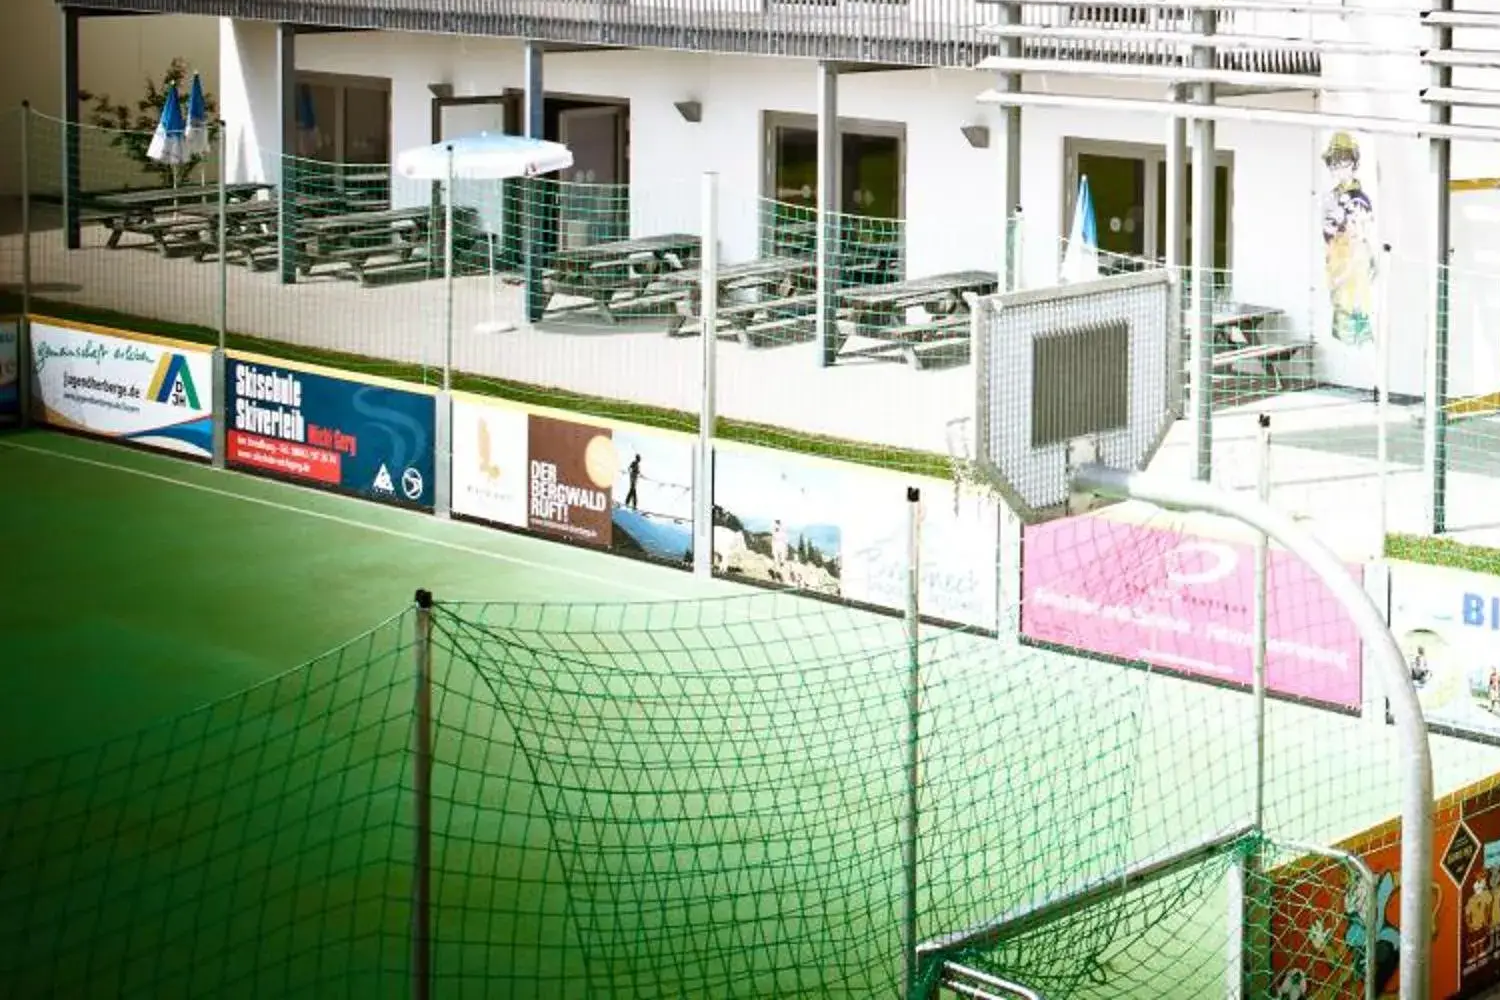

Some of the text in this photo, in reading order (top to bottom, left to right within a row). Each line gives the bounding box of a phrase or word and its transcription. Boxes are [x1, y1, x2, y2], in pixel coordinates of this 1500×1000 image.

[235, 363, 302, 407] Skischule
[235, 397, 305, 442] Skiverleih
[531, 460, 557, 483] DER
[531, 478, 607, 512] BERGWALD
[531, 497, 568, 522] RUFT!
